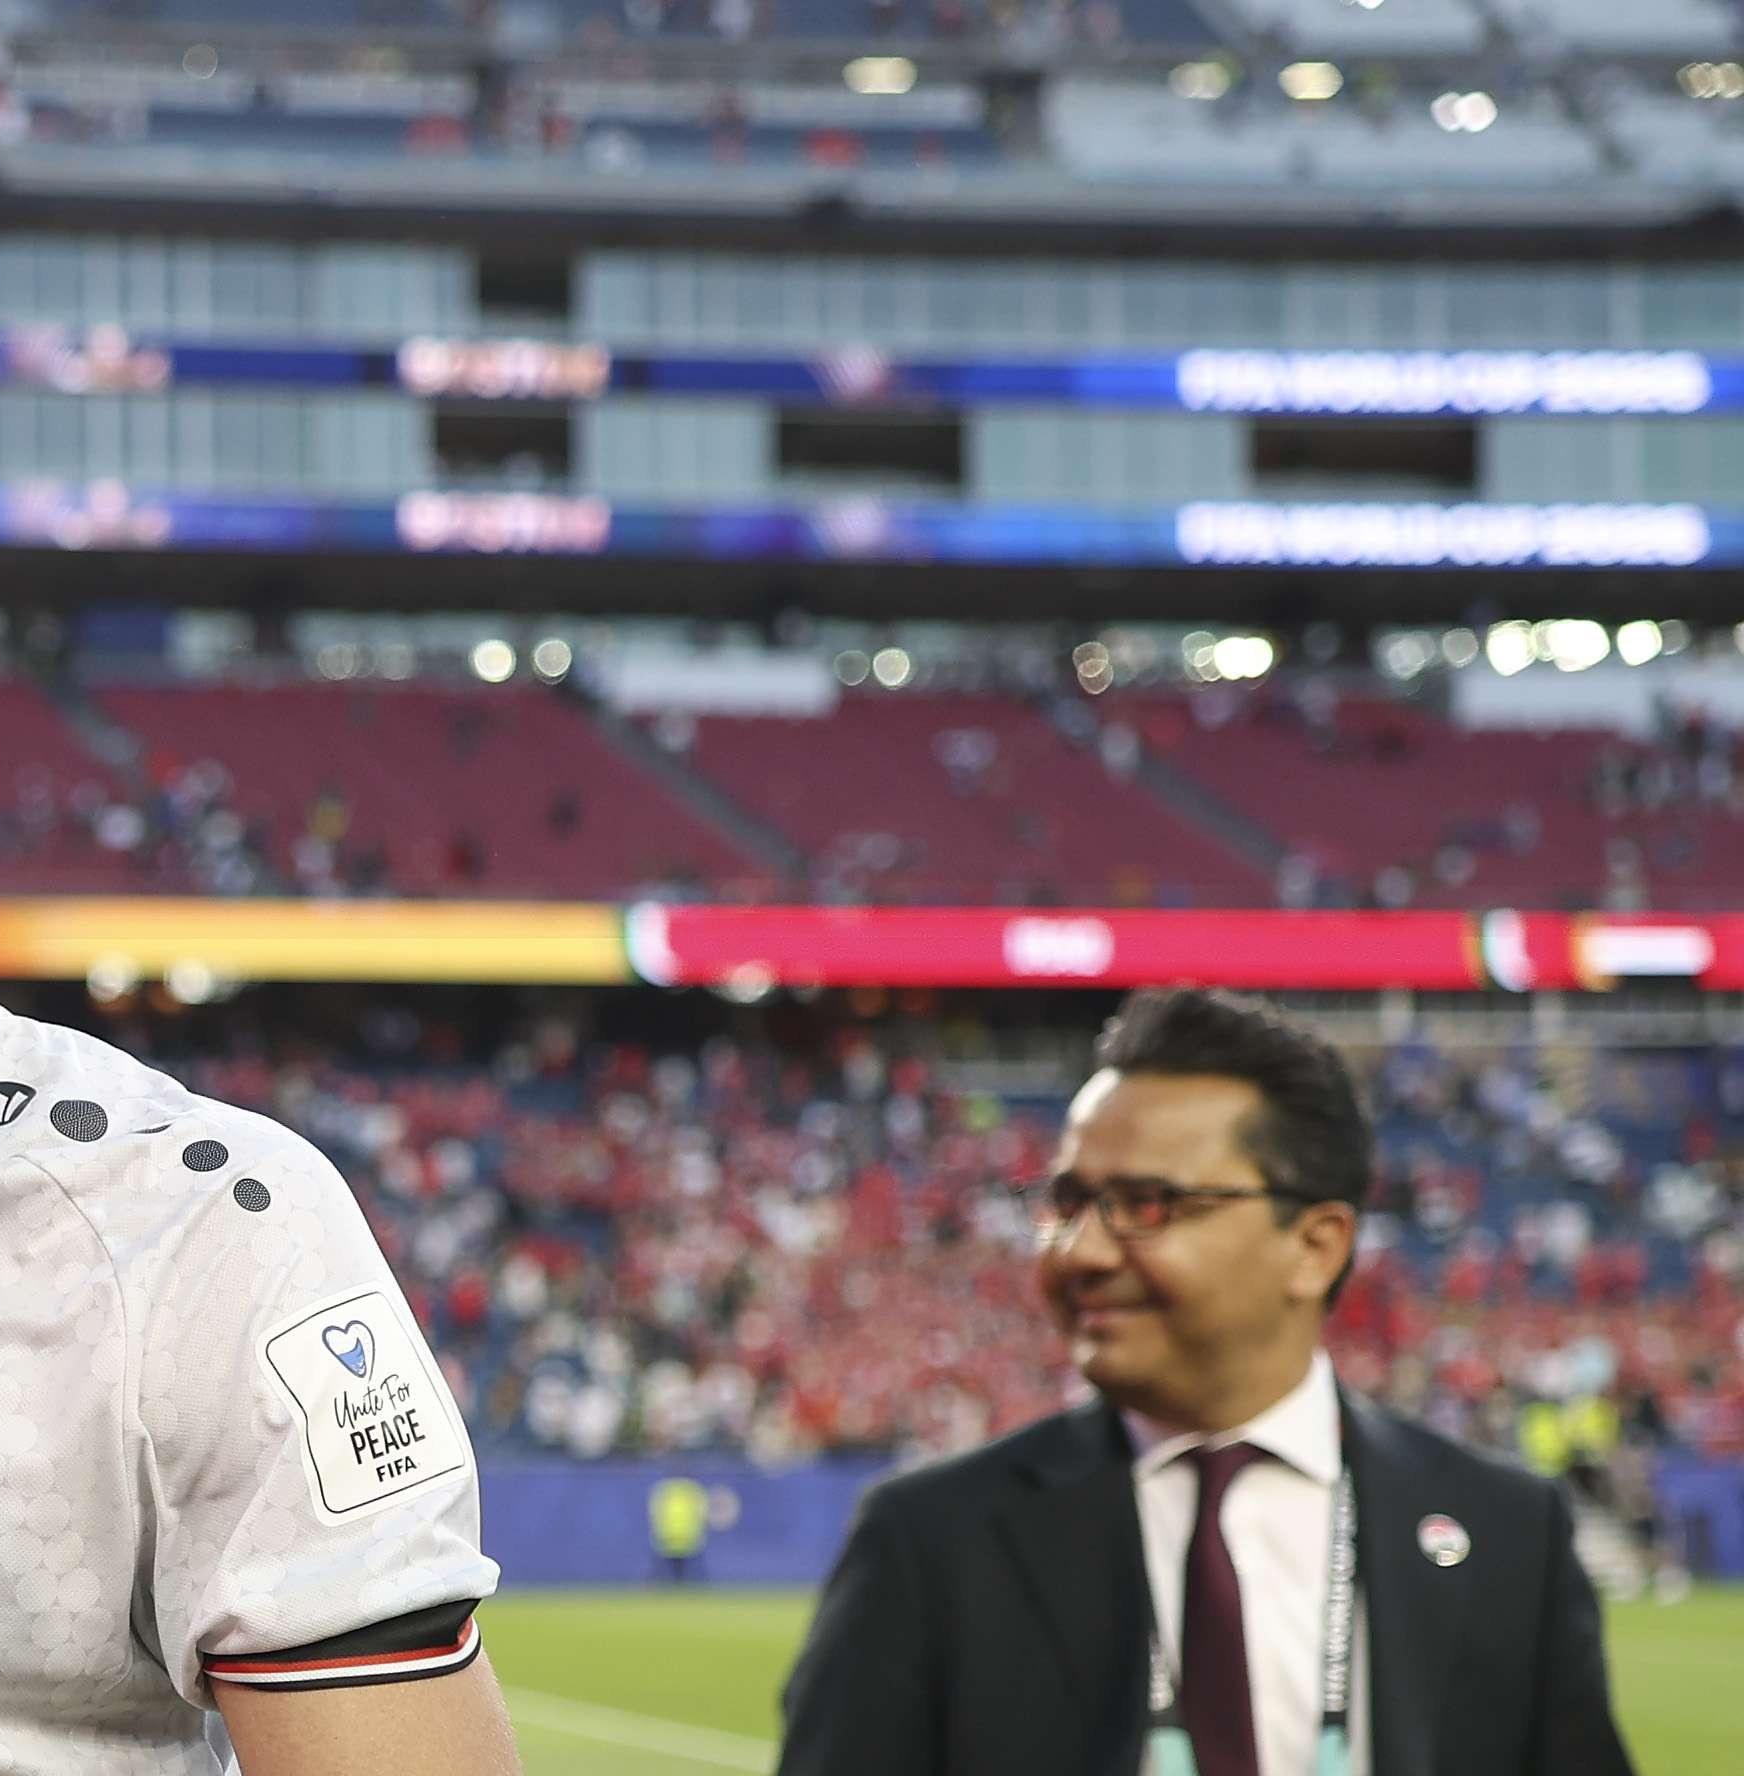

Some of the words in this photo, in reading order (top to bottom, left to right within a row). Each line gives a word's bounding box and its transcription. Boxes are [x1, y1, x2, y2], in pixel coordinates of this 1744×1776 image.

[334, 1386, 383, 1429] Unite
[380, 1374, 411, 1410] For
[350, 1408, 426, 1464] PEACE
[376, 1456, 417, 1482] FIFA
